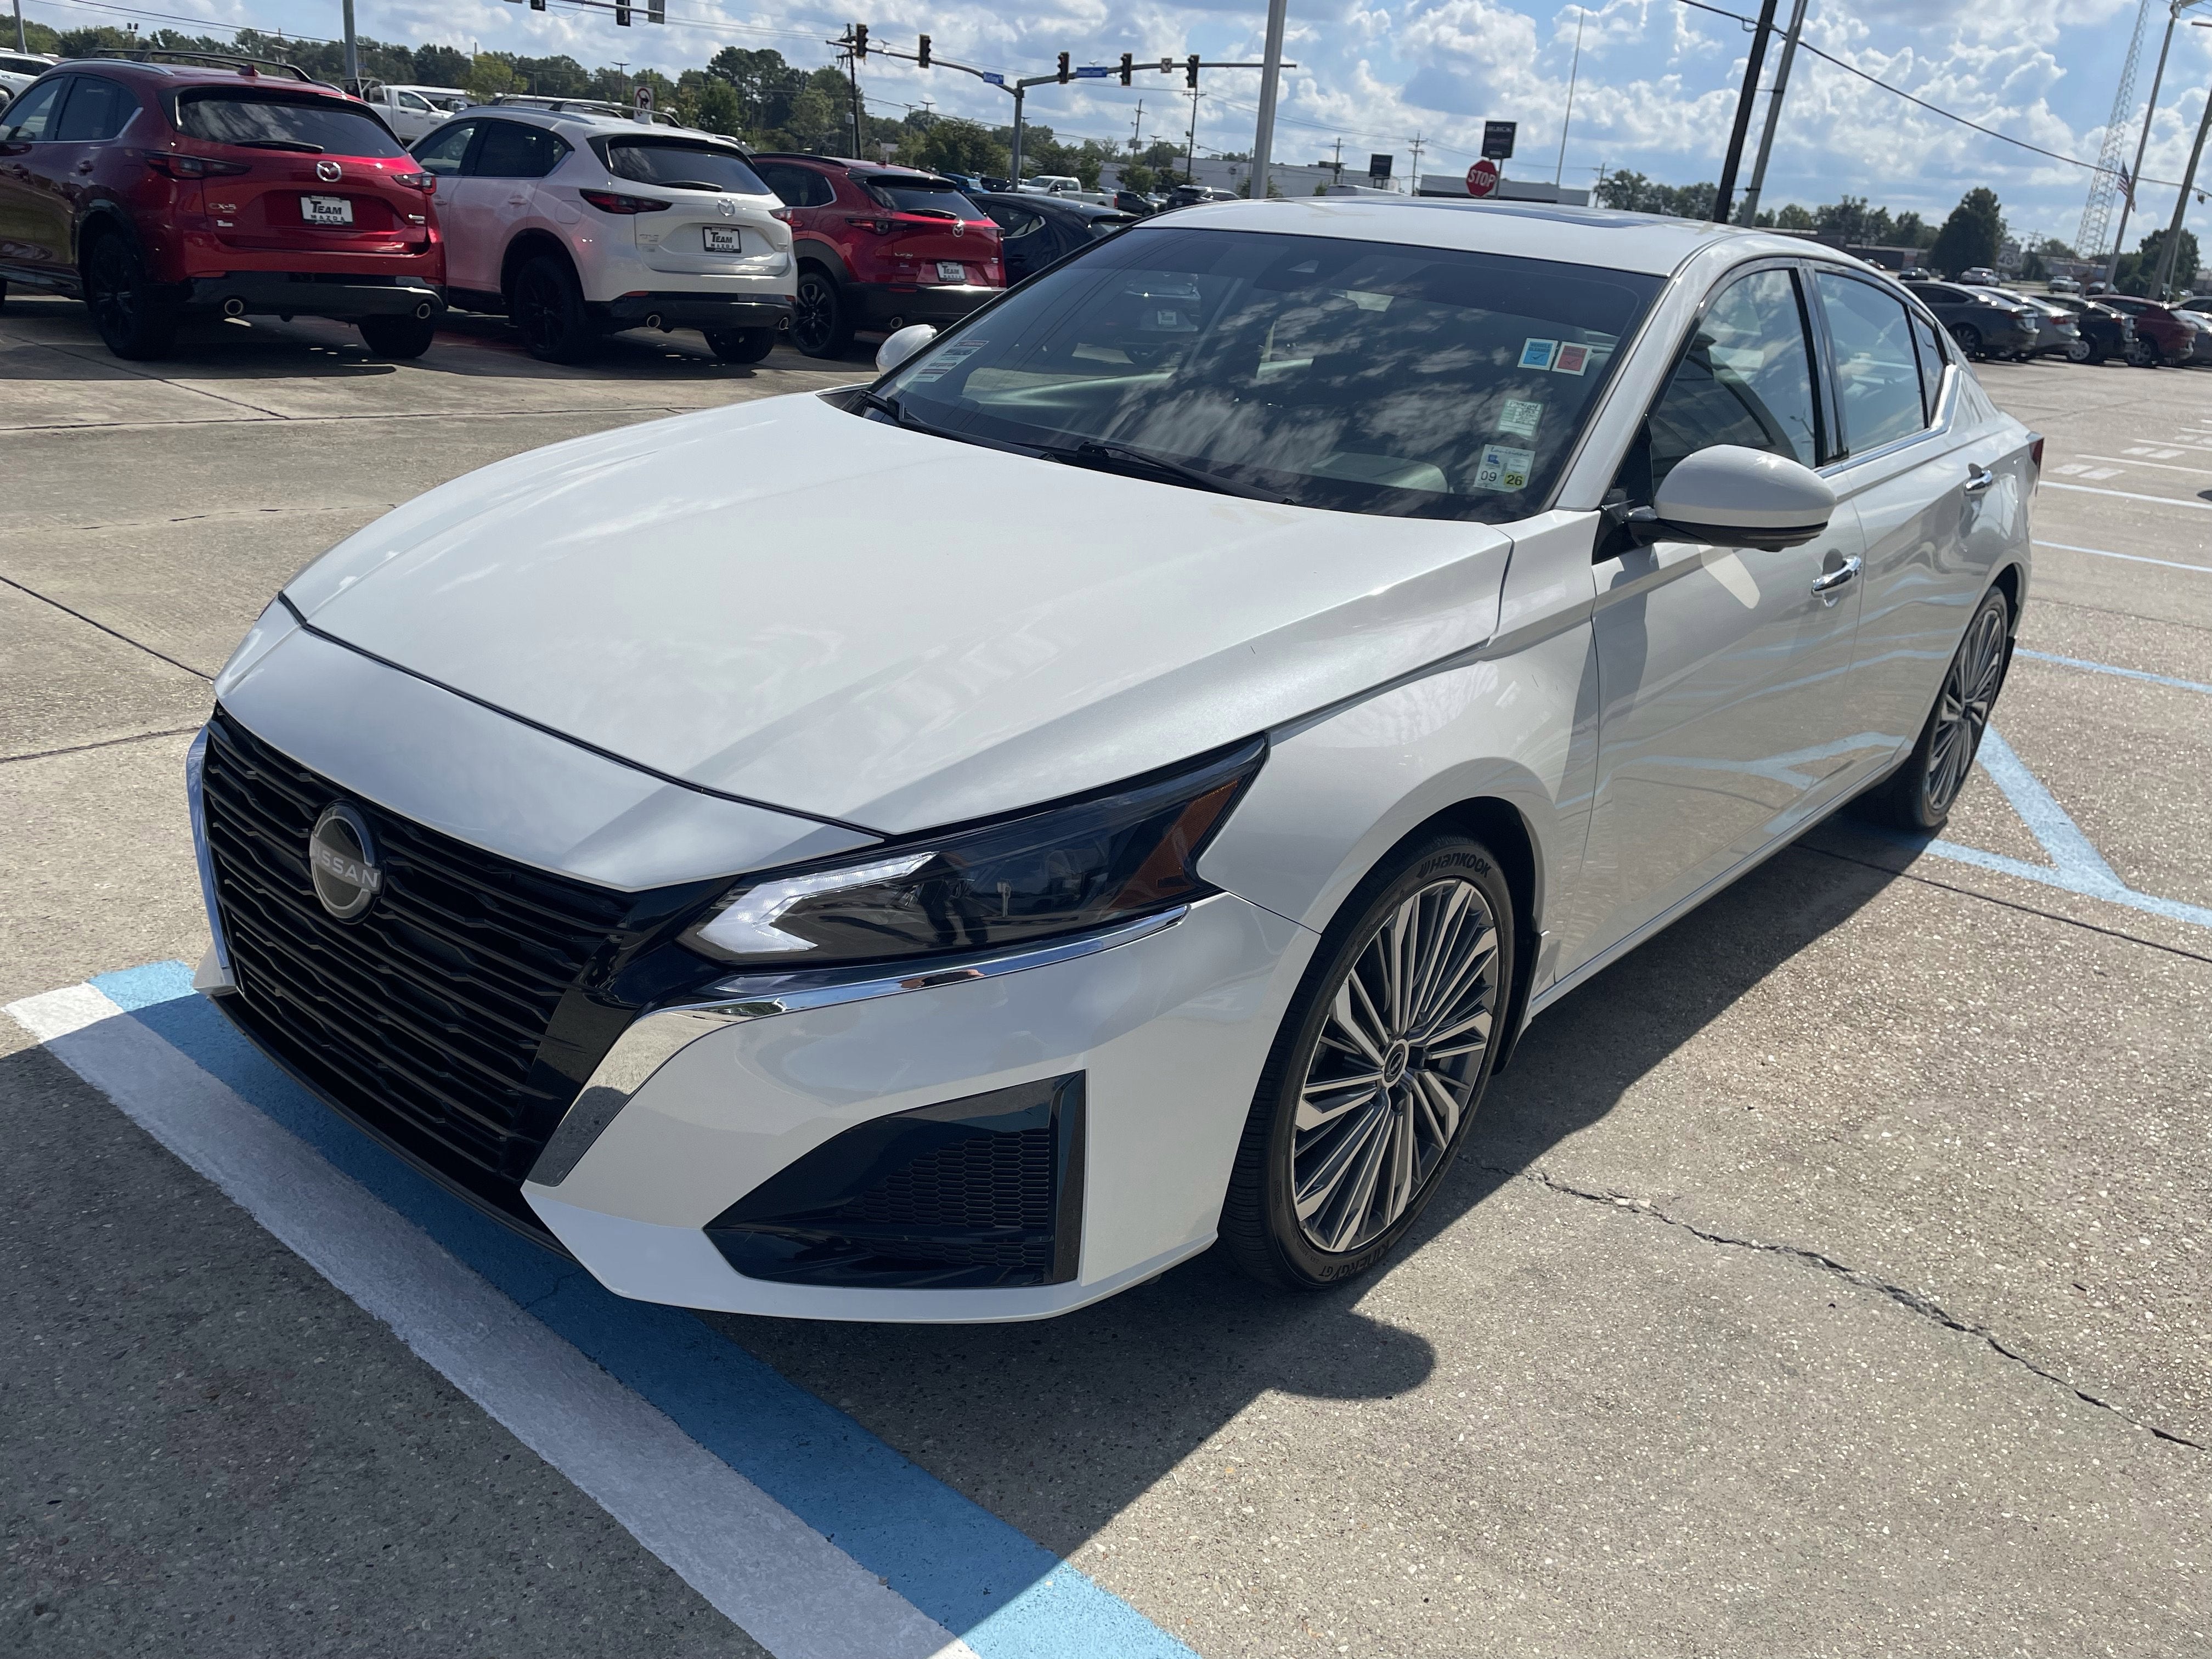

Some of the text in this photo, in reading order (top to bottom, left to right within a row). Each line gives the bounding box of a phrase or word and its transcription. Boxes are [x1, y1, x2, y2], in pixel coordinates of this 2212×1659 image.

[1468, 170, 1496, 188] STOP
[1491, 446, 1530, 456] Louisiana
[1481, 471, 1497, 482] 09
[1506, 475, 1523, 486] 26
